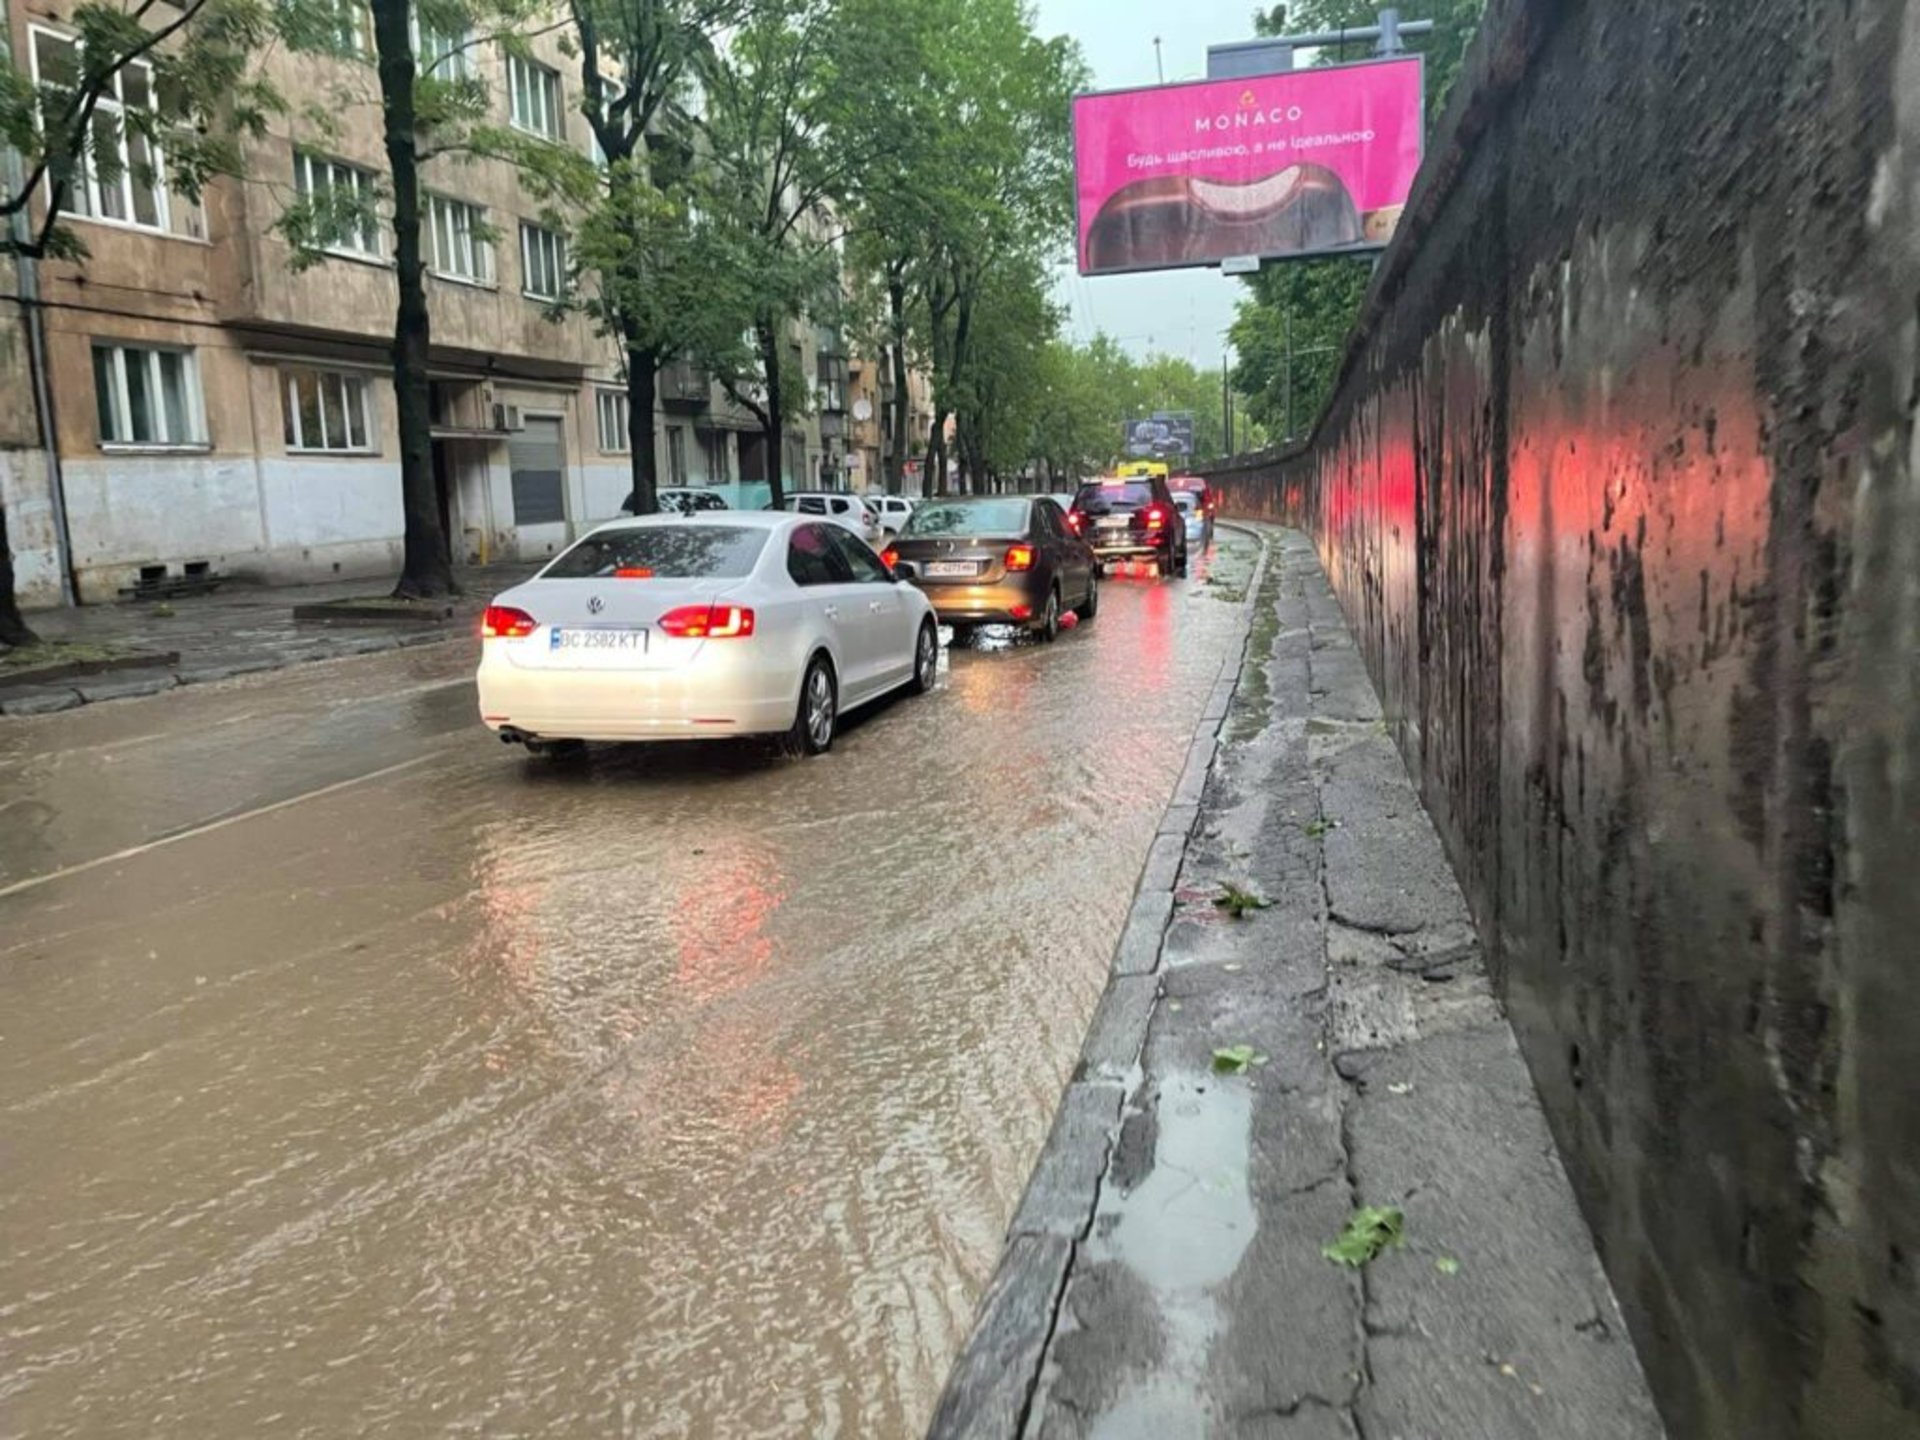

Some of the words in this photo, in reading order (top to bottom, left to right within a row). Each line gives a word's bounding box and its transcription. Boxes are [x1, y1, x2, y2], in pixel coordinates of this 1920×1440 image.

[1194, 106, 1302, 133] MONACO
[1127, 152, 1163, 169] Будь
[1267, 140, 1286, 152] не
[560, 632, 580, 648] BC
[584, 632, 615, 648] 2582
[619, 632, 640, 649] KT
